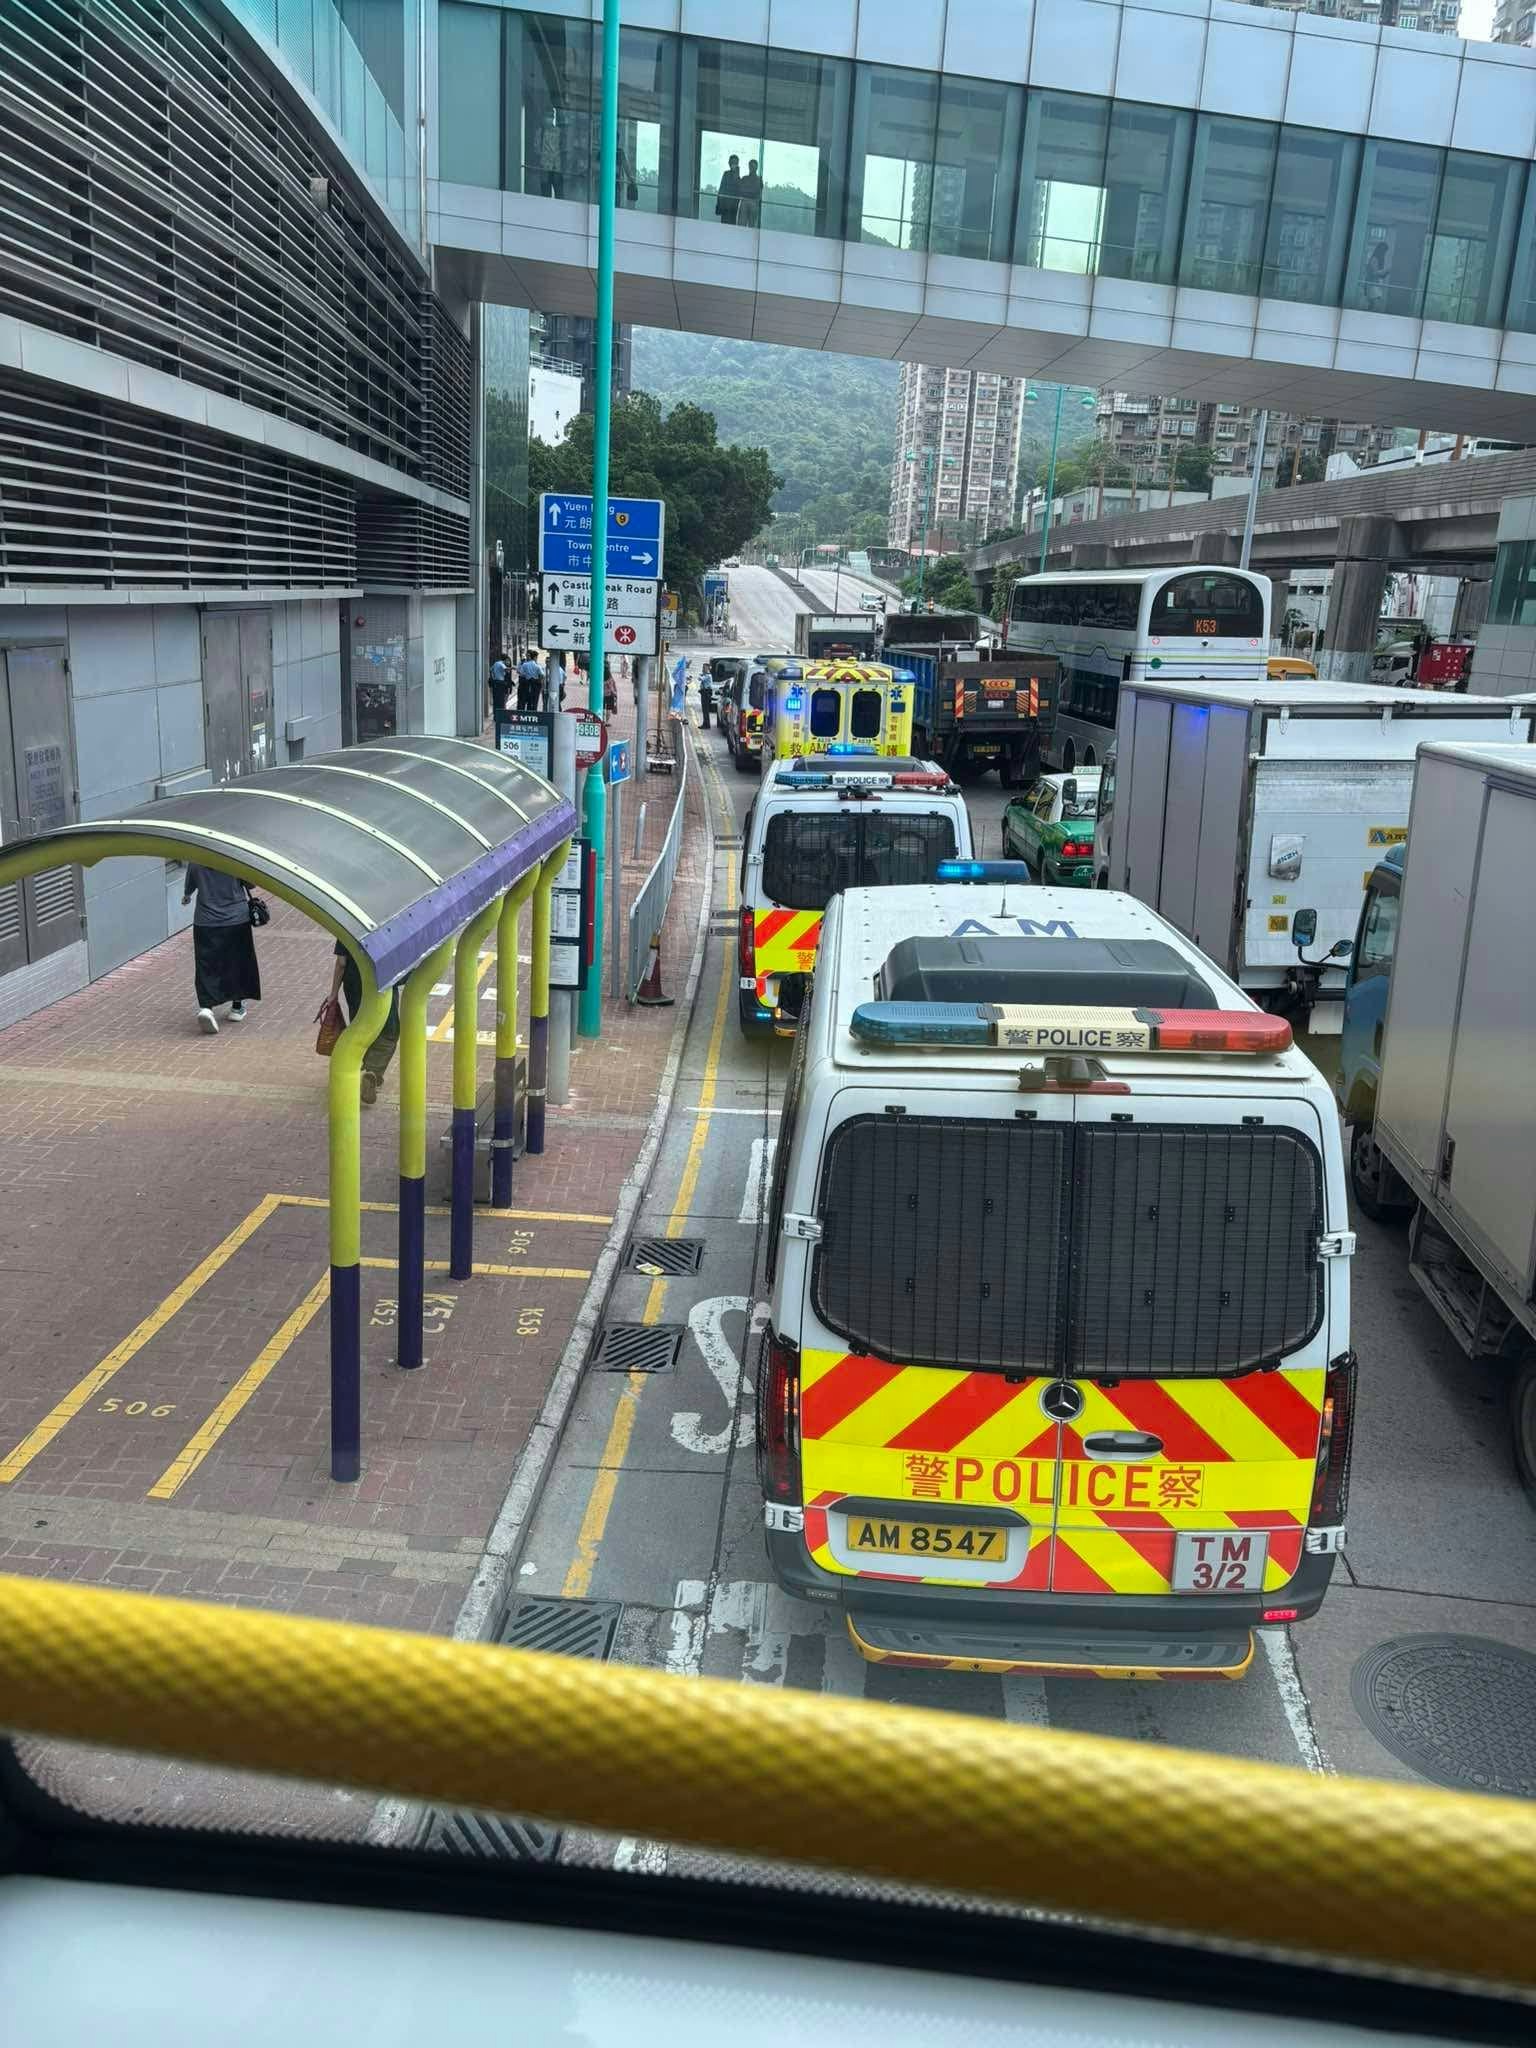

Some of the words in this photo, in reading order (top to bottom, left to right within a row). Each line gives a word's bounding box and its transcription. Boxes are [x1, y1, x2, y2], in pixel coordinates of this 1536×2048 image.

[564, 501, 588, 512] Yuen
[568, 540, 592, 550] Town
[605, 545, 630, 553] entre
[562, 580, 592, 590] Castl
[605, 585, 623, 593] eak
[626, 584, 652, 594] Road
[564, 595, 619, 611] 青山路
[1195, 619, 1217, 633] K53
[520, 715, 539, 723] MTR
[503, 741, 519, 750] 506
[847, 776, 878, 785] POLICE
[1037, 1029, 1112, 1046] POLICE
[1116, 1031, 1145, 1047] 察
[507, 1230, 535, 1255] 506
[369, 1299, 399, 1326] K52
[516, 1308, 545, 1336] K58
[97, 1398, 177, 1417] 506
[953, 1458, 1153, 1508] POLICE
[858, 1523, 900, 1549] AM
[910, 1527, 996, 1556] 8547
[1192, 1562, 1247, 1589] 3/2
